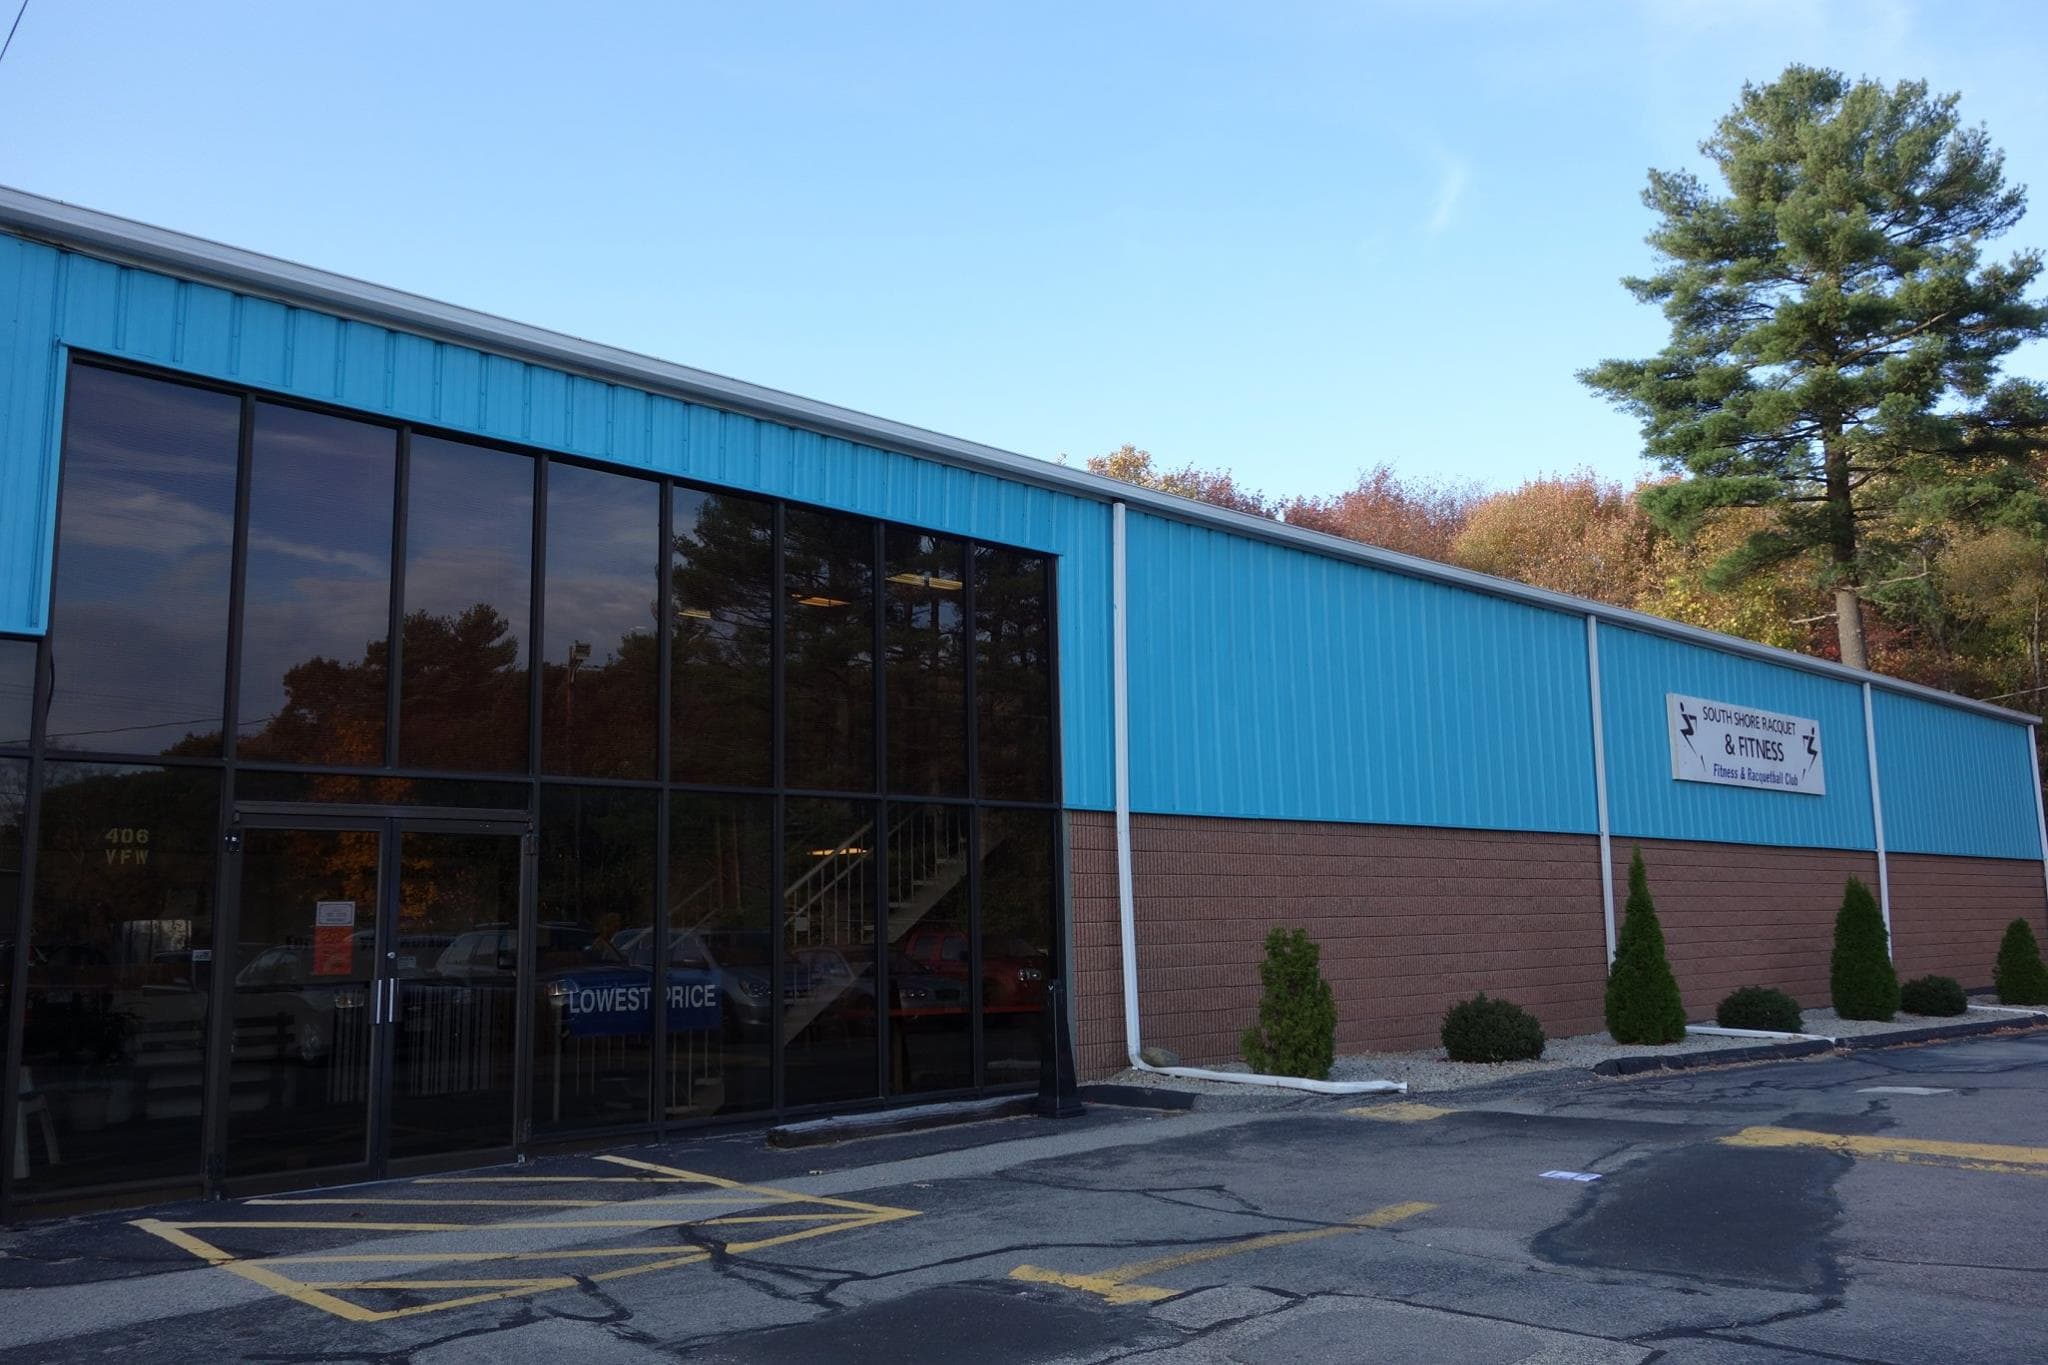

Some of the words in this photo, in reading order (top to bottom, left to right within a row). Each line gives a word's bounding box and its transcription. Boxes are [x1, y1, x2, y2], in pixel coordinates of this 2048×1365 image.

[1703, 706, 1733, 726] SOUTH
[1734, 712, 1761, 730] SHORE
[1762, 717, 1796, 736] RACQUET
[1725, 734, 1735, 755] &
[1739, 736, 1785, 762] FITNESS
[1713, 763, 1739, 780] Fitness
[1740, 767, 1746, 780] &
[1747, 767, 1784, 785] Racquetball
[1785, 773, 1799, 786] Club
[105, 828, 149, 844] 406
[569, 987, 652, 1014] LOWEST
